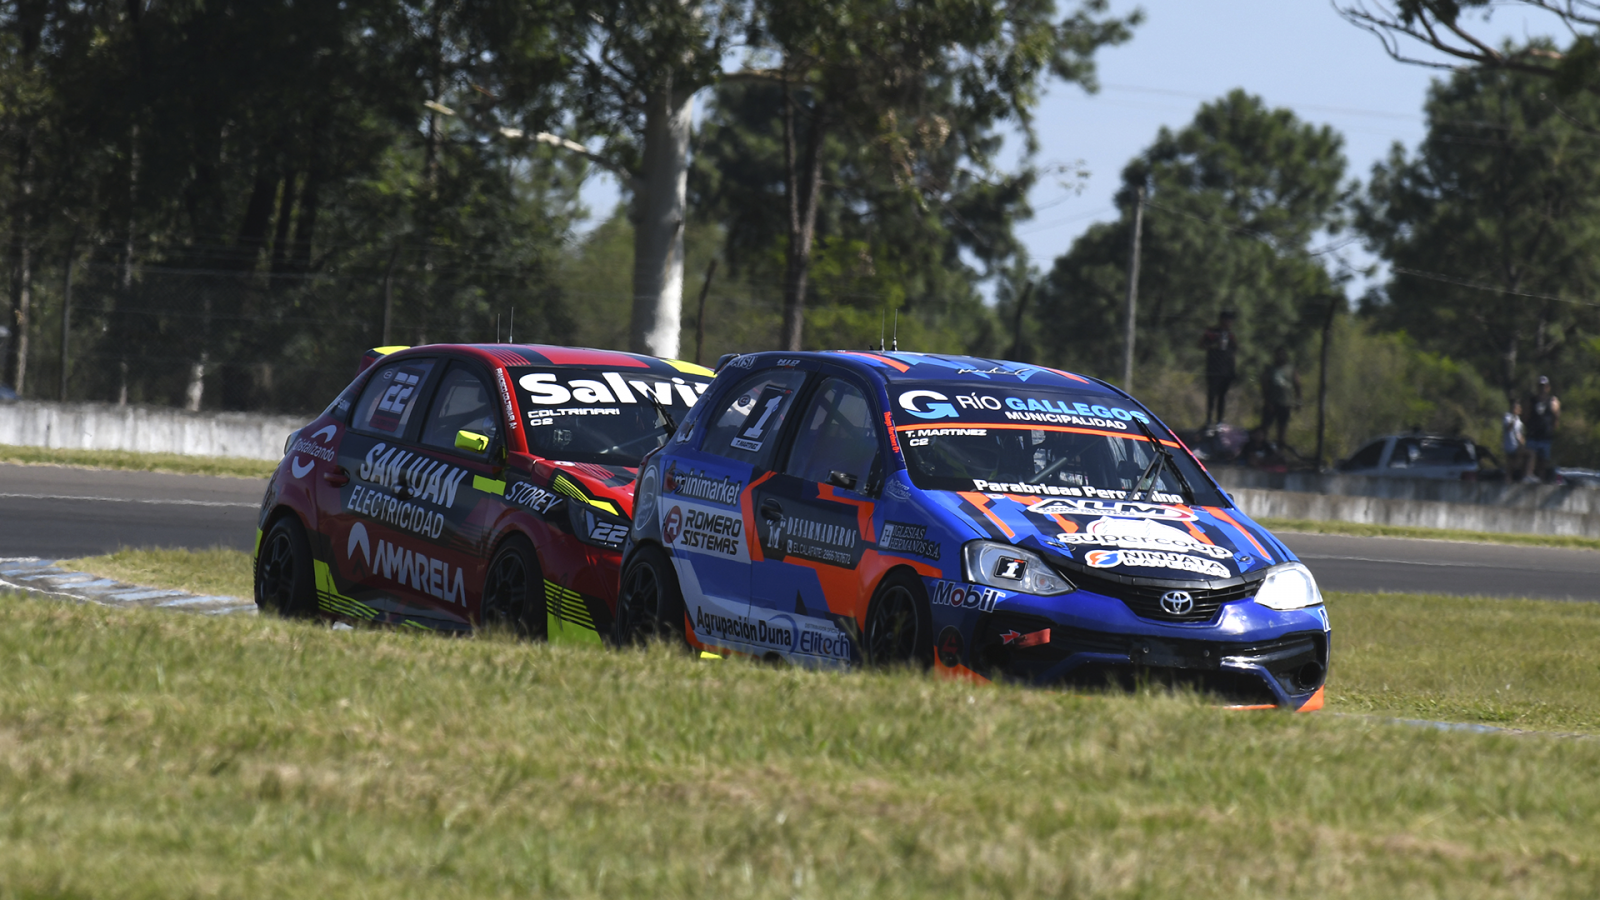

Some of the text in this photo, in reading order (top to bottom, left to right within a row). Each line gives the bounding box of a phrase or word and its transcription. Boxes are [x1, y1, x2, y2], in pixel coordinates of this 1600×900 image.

[527, 408, 620, 419] COLTRINARI
[743, 395, 783, 439] 1
[956, 391, 1150, 425] RÍO GALLEGOS
[1004, 410, 1128, 430] MUNICIPALIDAD
[530, 417, 553, 427] C2
[905, 428, 987, 438] T. MARTINEZ
[909, 438, 929, 447] C2
[360, 442, 468, 509] SAN JUAN
[674, 468, 741, 505] minimarket
[973, 479, 1082, 497] Parabrisas
[505, 481, 563, 515] STOREY
[347, 485, 445, 540] ELECTRICIDAD
[685, 509, 742, 538] ROMERO
[590, 521, 630, 544] 22
[681, 529, 740, 556] SISTEMAS
[786, 517, 857, 548] DESARMADEROS
[892, 525, 926, 540] IGLESIAS
[1063, 533, 1229, 557] supercoop
[889, 538, 940, 559] HERMANOS S.A.
[1123, 551, 1224, 571] NINJATA
[372, 539, 467, 608] AMARELA
[1001, 562, 1019, 578] 1
[933, 580, 999, 613] Mobil
[697, 606, 792, 646] Agrupación Duna
[800, 630, 849, 658] Elitech
